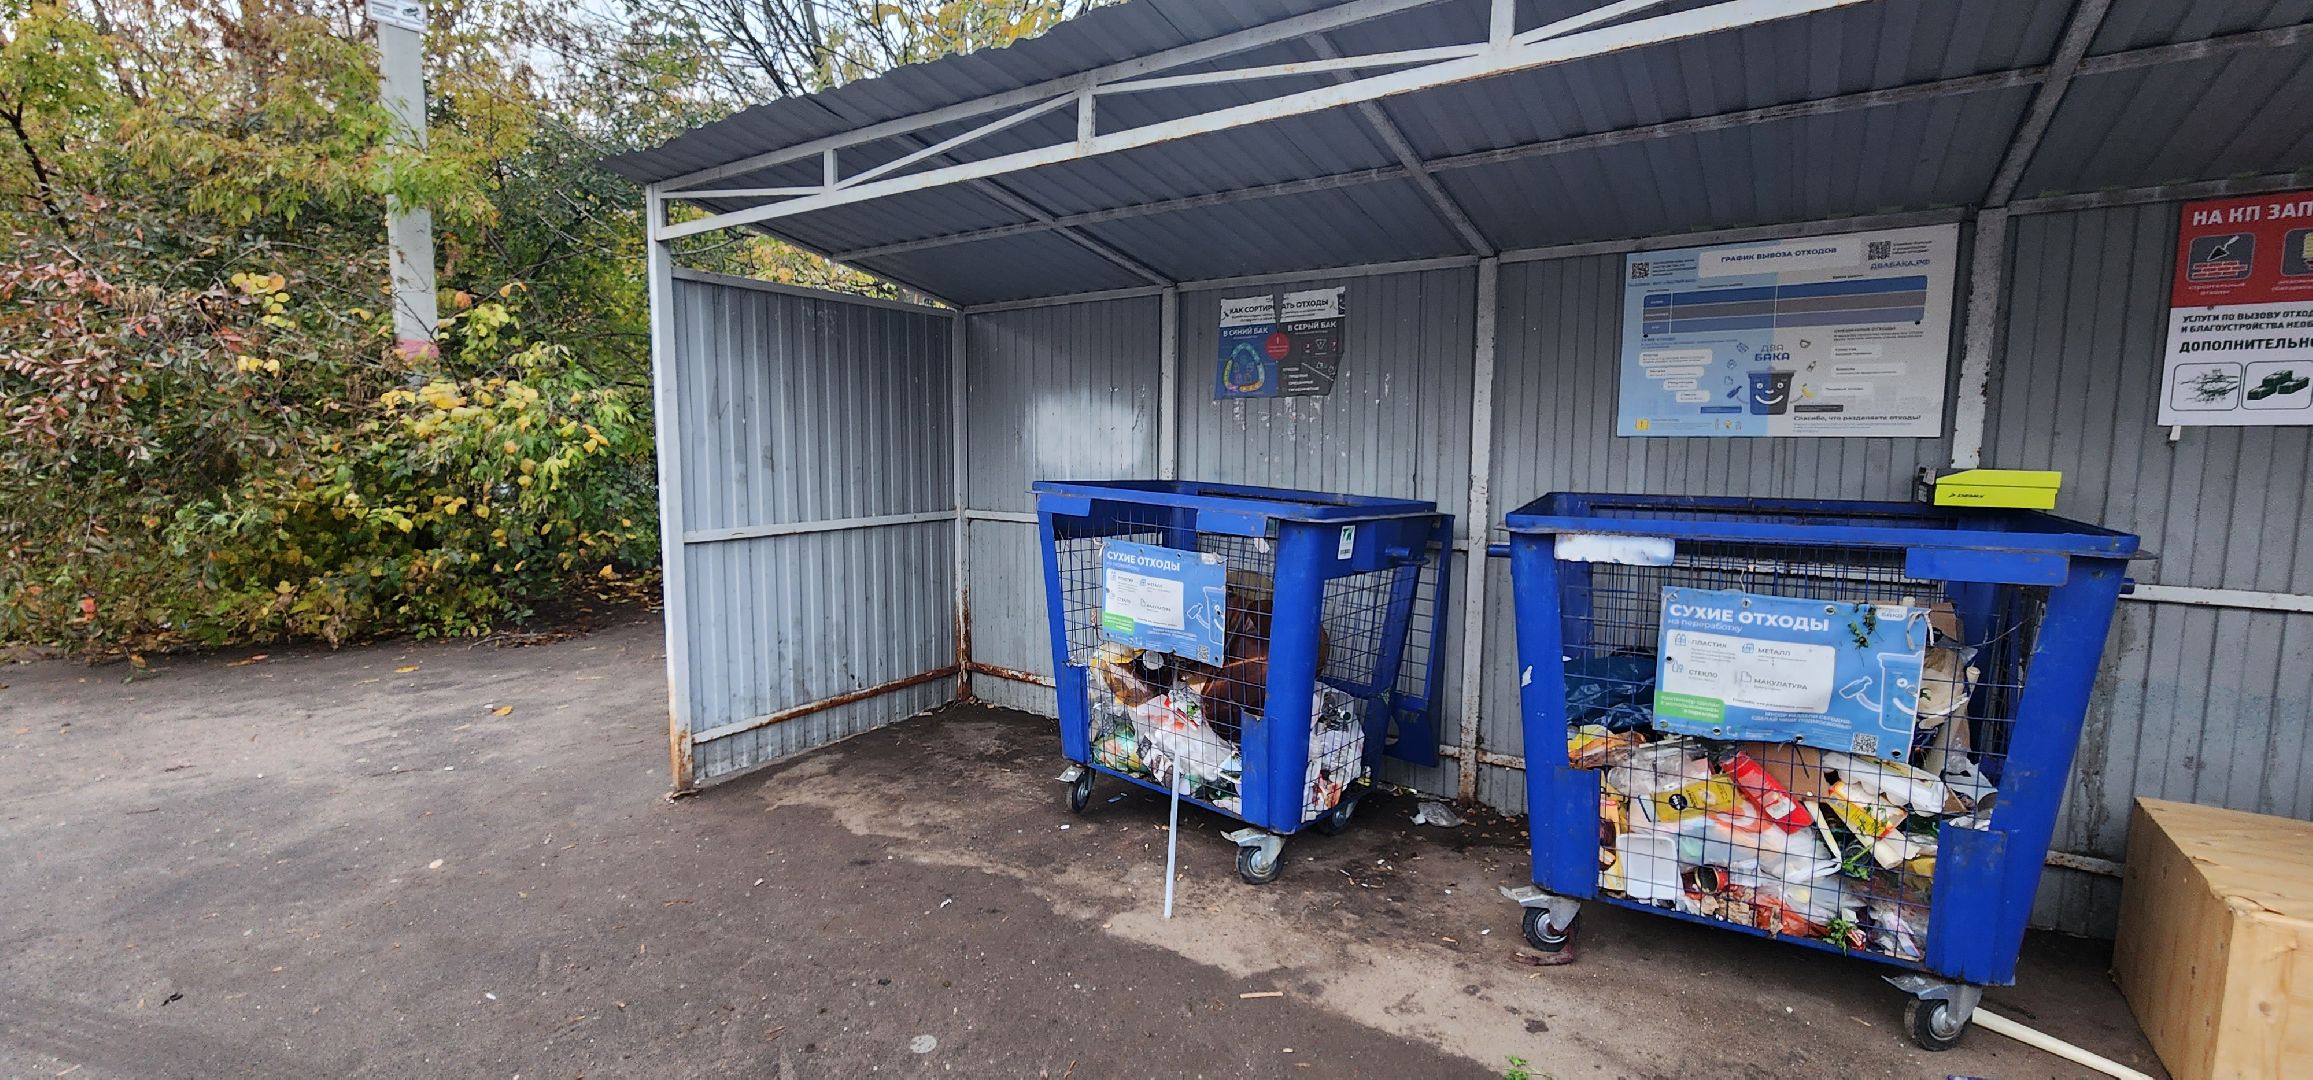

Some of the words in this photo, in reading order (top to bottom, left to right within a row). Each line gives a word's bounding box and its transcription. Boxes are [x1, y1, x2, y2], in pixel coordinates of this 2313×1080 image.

[2193, 210, 2223, 226] НА
[2228, 205, 2261, 223] КП
[2267, 201, 2313, 220] ЗАП
[1721, 254, 1754, 263] ГРАФИК
[1756, 250, 1793, 261] ВЫВОЗА
[1795, 247, 1837, 258] ОТХОДОВ
[1230, 306, 1243, 314] КАК
[1244, 302, 1294, 313] СОРТИРАТЬ
[1296, 299, 1329, 308] ОТХОДЫ
[2183, 314, 2219, 323] УСЛУГИ
[2221, 313, 2235, 321] ПО
[1229, 327, 1253, 336] СИНИЙ
[1253, 326, 1269, 334] БАК
[1294, 321, 1319, 331] СЕРЫЙ
[1320, 321, 1337, 329] БАК
[2181, 325, 2189, 333] И
[2189, 321, 2283, 333] БЛАГОУСТРОЙСТВА
[1760, 344, 1784, 352] ДВА
[1754, 352, 1790, 361] БАКА
[1107, 551, 1136, 564] СУХИЕ
[1137, 556, 1180, 572] ОТХОДЫ
[1669, 604, 1734, 623] СУХИЕ
[1738, 613, 1829, 632] ОТХОДЫ
[1681, 619, 1743, 633] переработку
[1691, 639, 1727, 649] ПЛАСТИК
[1758, 647, 1791, 656] МЕТАЛЛ
[1689, 669, 1718, 679] СТЕКЛО
[1754, 677, 1808, 690] МАКУЛАТУРА
